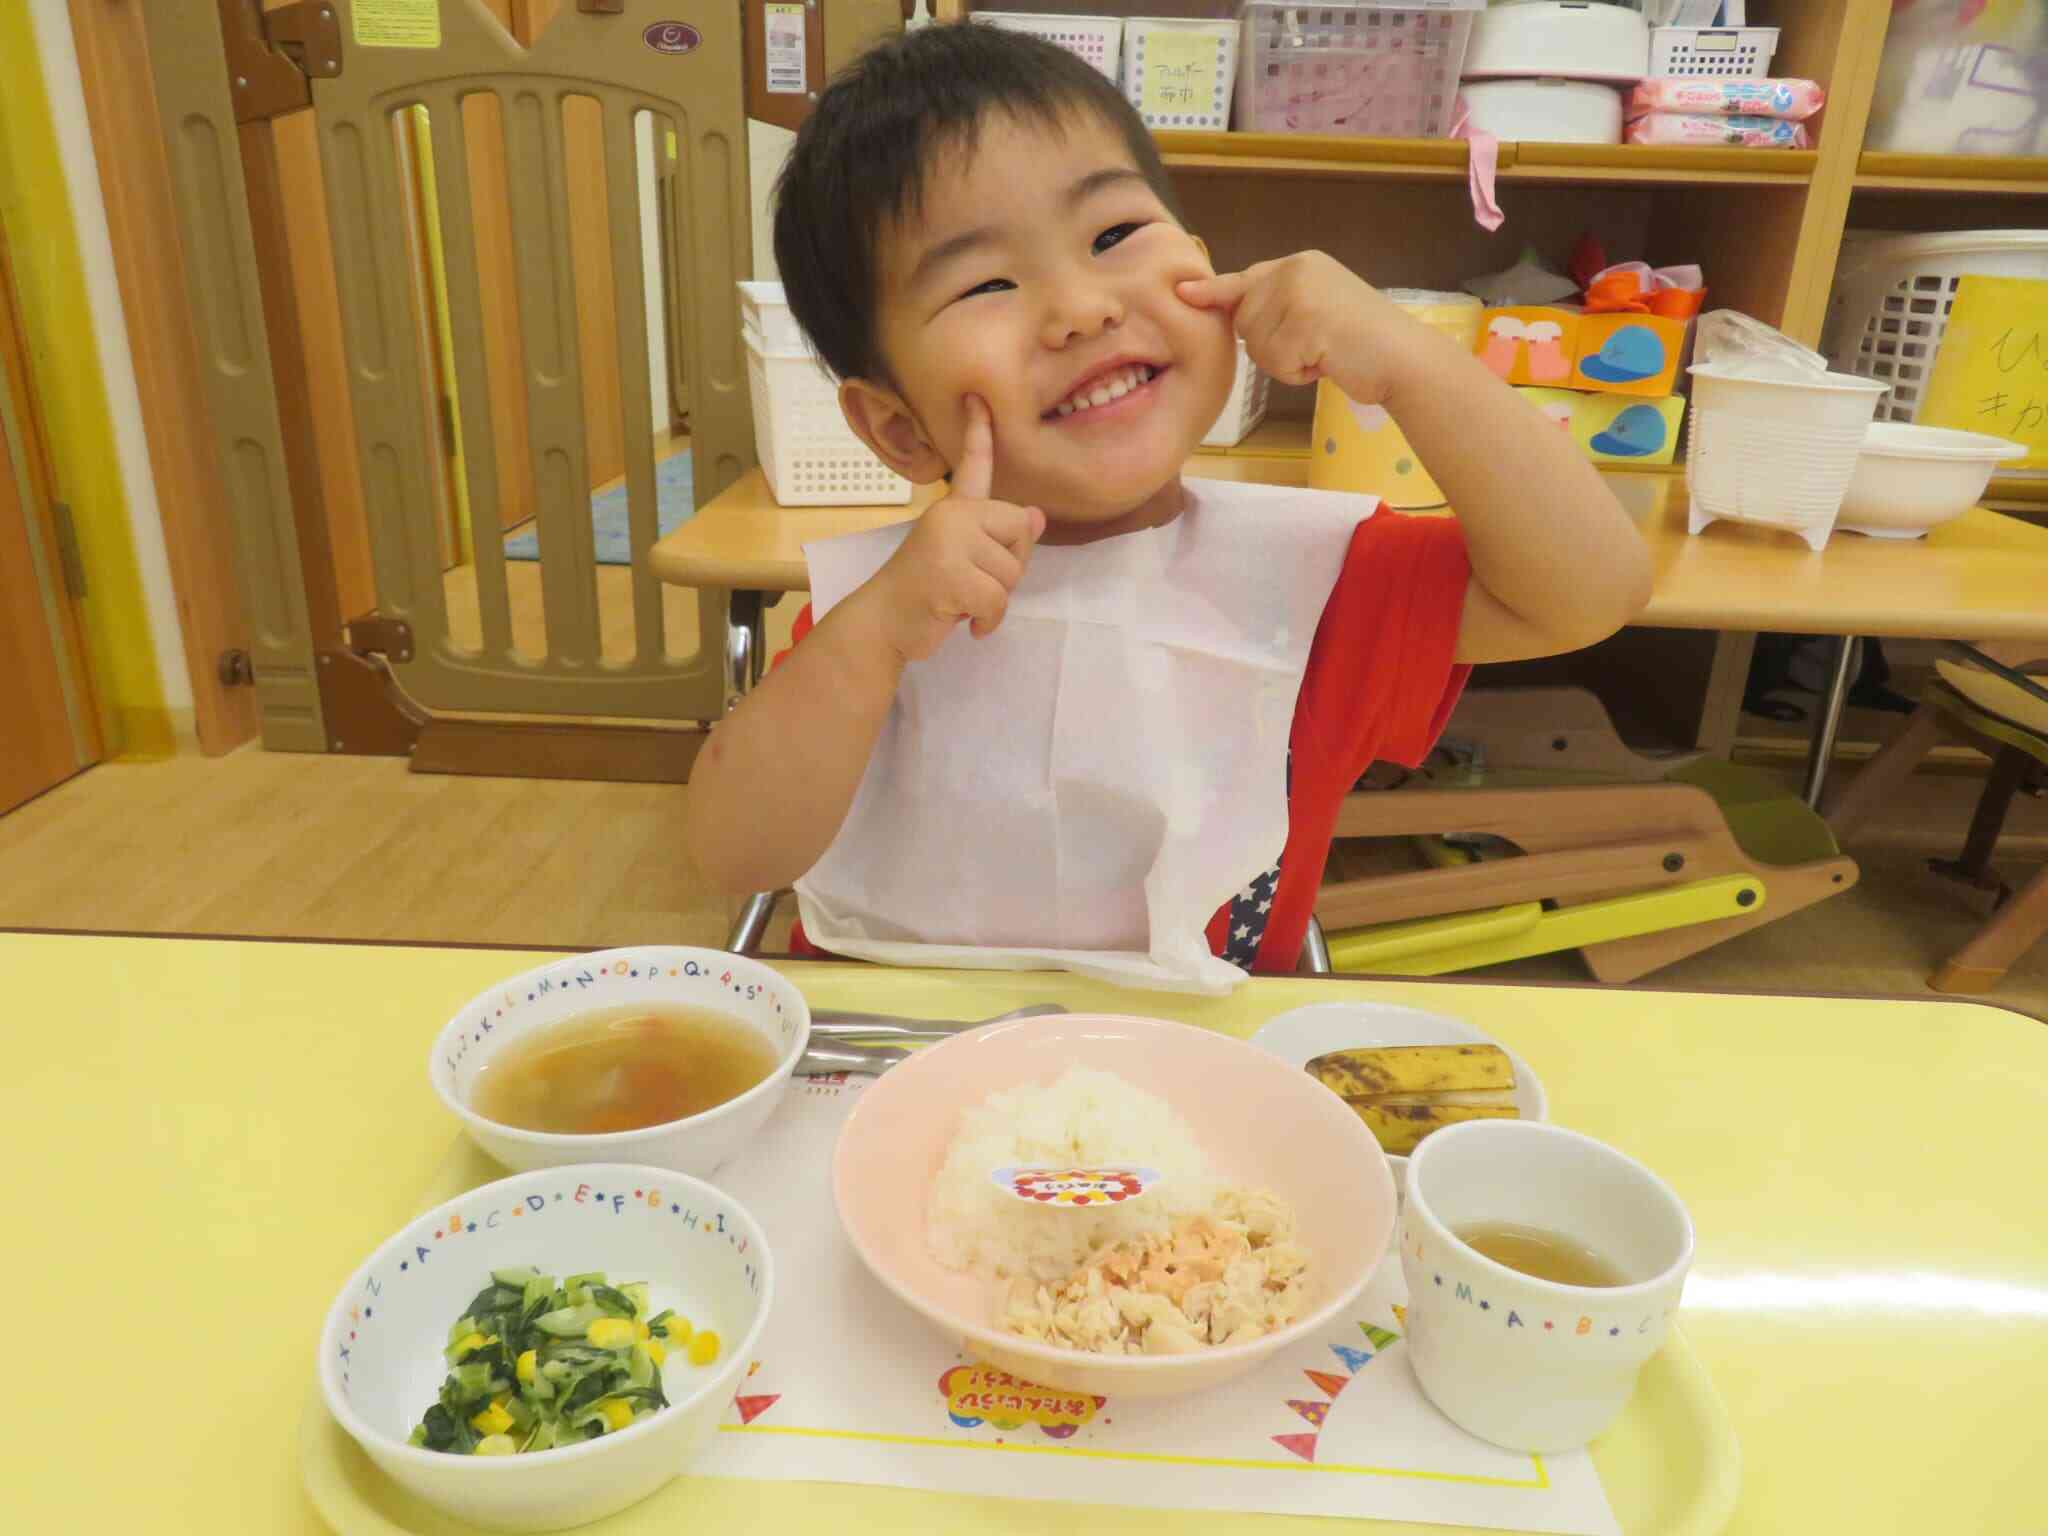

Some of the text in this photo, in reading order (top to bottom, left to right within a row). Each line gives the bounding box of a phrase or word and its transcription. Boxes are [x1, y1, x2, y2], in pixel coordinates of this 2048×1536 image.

[481, 1016, 493, 1032] K
[537, 977, 555, 996] M
[576, 970, 594, 988] N
[614, 960, 629, 976] O
[648, 966, 659, 981] P
[684, 960, 701, 977] Q
[746, 985, 756, 1001] S
[416, 1245, 431, 1263] A
[450, 1215, 462, 1233] B
[487, 1210, 500, 1228] C
[526, 1194, 545, 1211] D
[574, 1183, 591, 1203] E
[612, 1195, 625, 1214] F
[682, 1209, 698, 1229] H
[716, 1213, 725, 1233] I
[1456, 1282, 1473, 1304] M
[1507, 1310, 1524, 1328] A
[1575, 1314, 1593, 1336] B
[956, 1392, 1085, 1416] おたんじょうび
